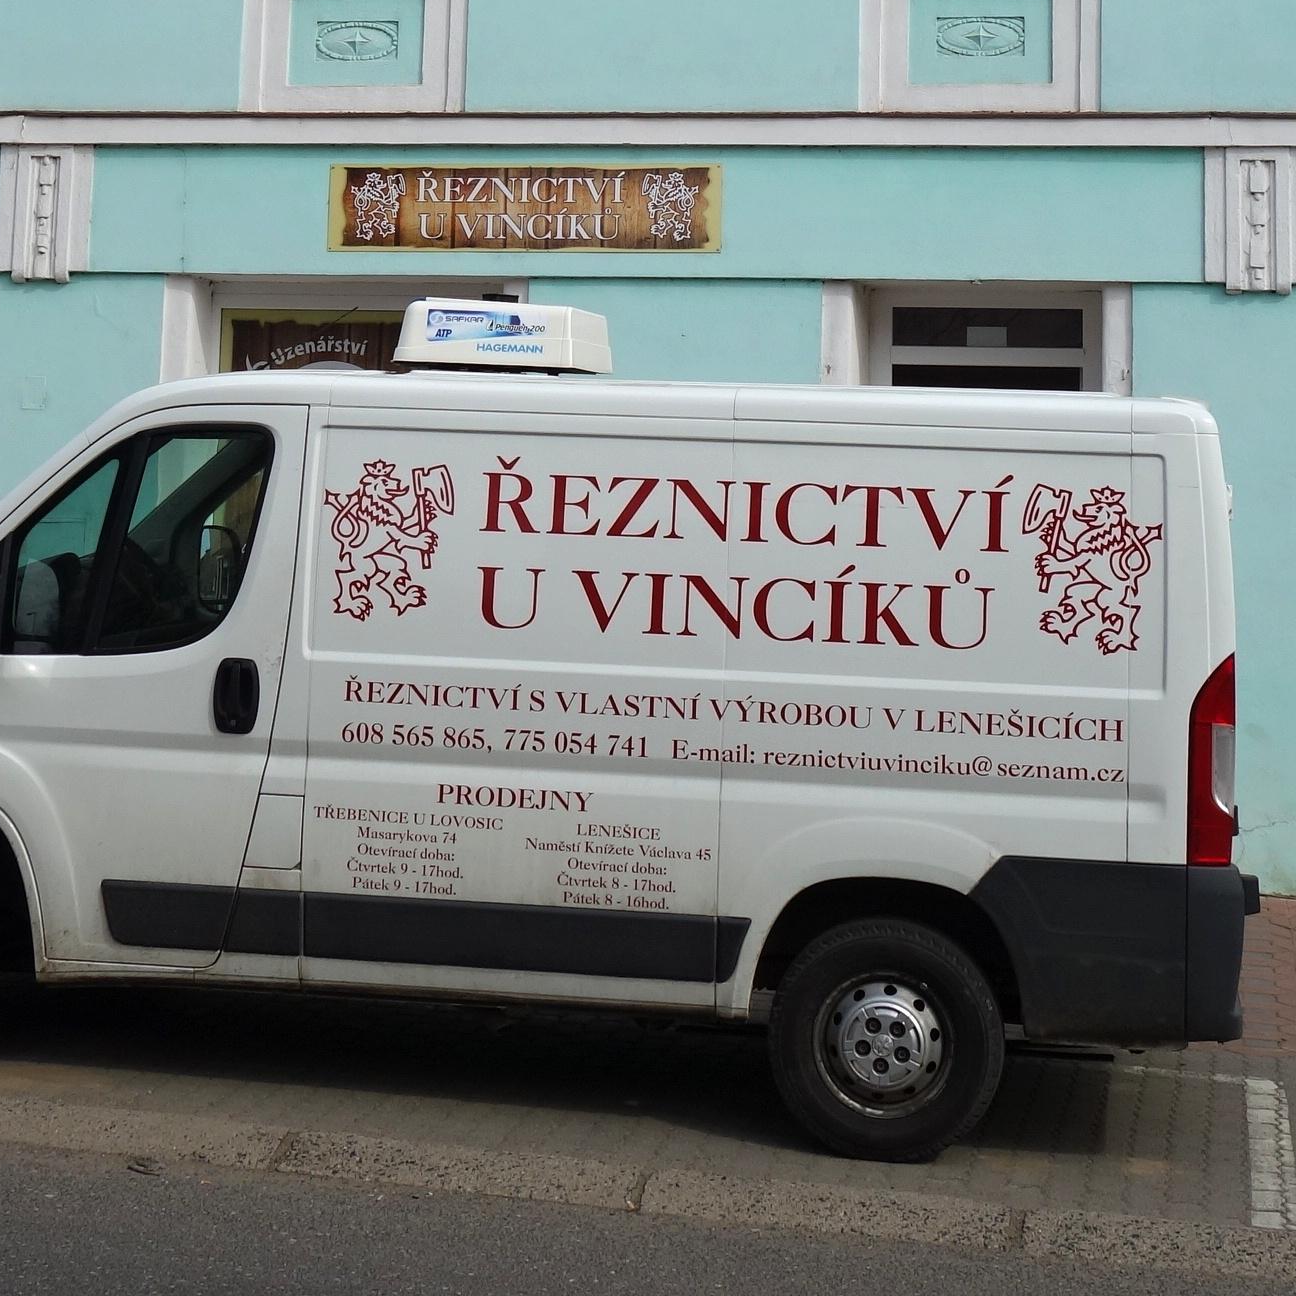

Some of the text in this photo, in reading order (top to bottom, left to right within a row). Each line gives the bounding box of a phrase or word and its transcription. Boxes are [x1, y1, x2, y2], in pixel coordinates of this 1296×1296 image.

[416, 170, 625, 203] ŘEZNICTVÍ
[419, 206, 621, 240] U VINCÍKŮ
[445, 315, 485, 323] SAFKAR
[435, 329, 452, 338] ATP
[476, 343, 543, 354] HAGEMANN
[479, 455, 1015, 554] ŘEZNICTVÍ
[477, 563, 996, 650] U VINCÍKŮ
[344, 675, 1125, 742] ŘEZNICTVÍ S VLASTNÍ VÝROBOU V LENEŠICÍCH
[341, 722, 384, 745] 608
[391, 724, 434, 747] 565
[442, 726, 493, 754] 865,
[503, 728, 545, 753] 775
[554, 730, 598, 756] 054
[607, 733, 649, 758] 741
[671, 739, 756, 764] E-mail:
[437, 782, 595, 813] PRODEJNY
[313, 804, 504, 831] TŘEBENICE U LOVOSIC
[357, 826, 457, 844] Masarykova 74
[577, 823, 661, 841] LENEŠICE
[357, 843, 455, 861] Otevírací doba:
[585, 840, 635, 856] Knížete
[639, 844, 692, 860] Václava
[695, 848, 712, 861] 45
[346, 856, 396, 875] Čtvrtek
[400, 862, 408, 875] 9
[422, 864, 464, 879] 17hod.
[567, 857, 667, 876] Otevírací doba:
[352, 876, 390, 891] Pátek
[393, 879, 401, 891] 9
[415, 881, 457, 896] 17hod.
[557, 870, 608, 889] Čtvrtek
[611, 876, 620, 889] 8
[633, 877, 676, 894] 17hod.
[562, 889, 601, 906] Pátek
[604, 892, 613, 906] 8
[626, 894, 670, 910] 16hod.
